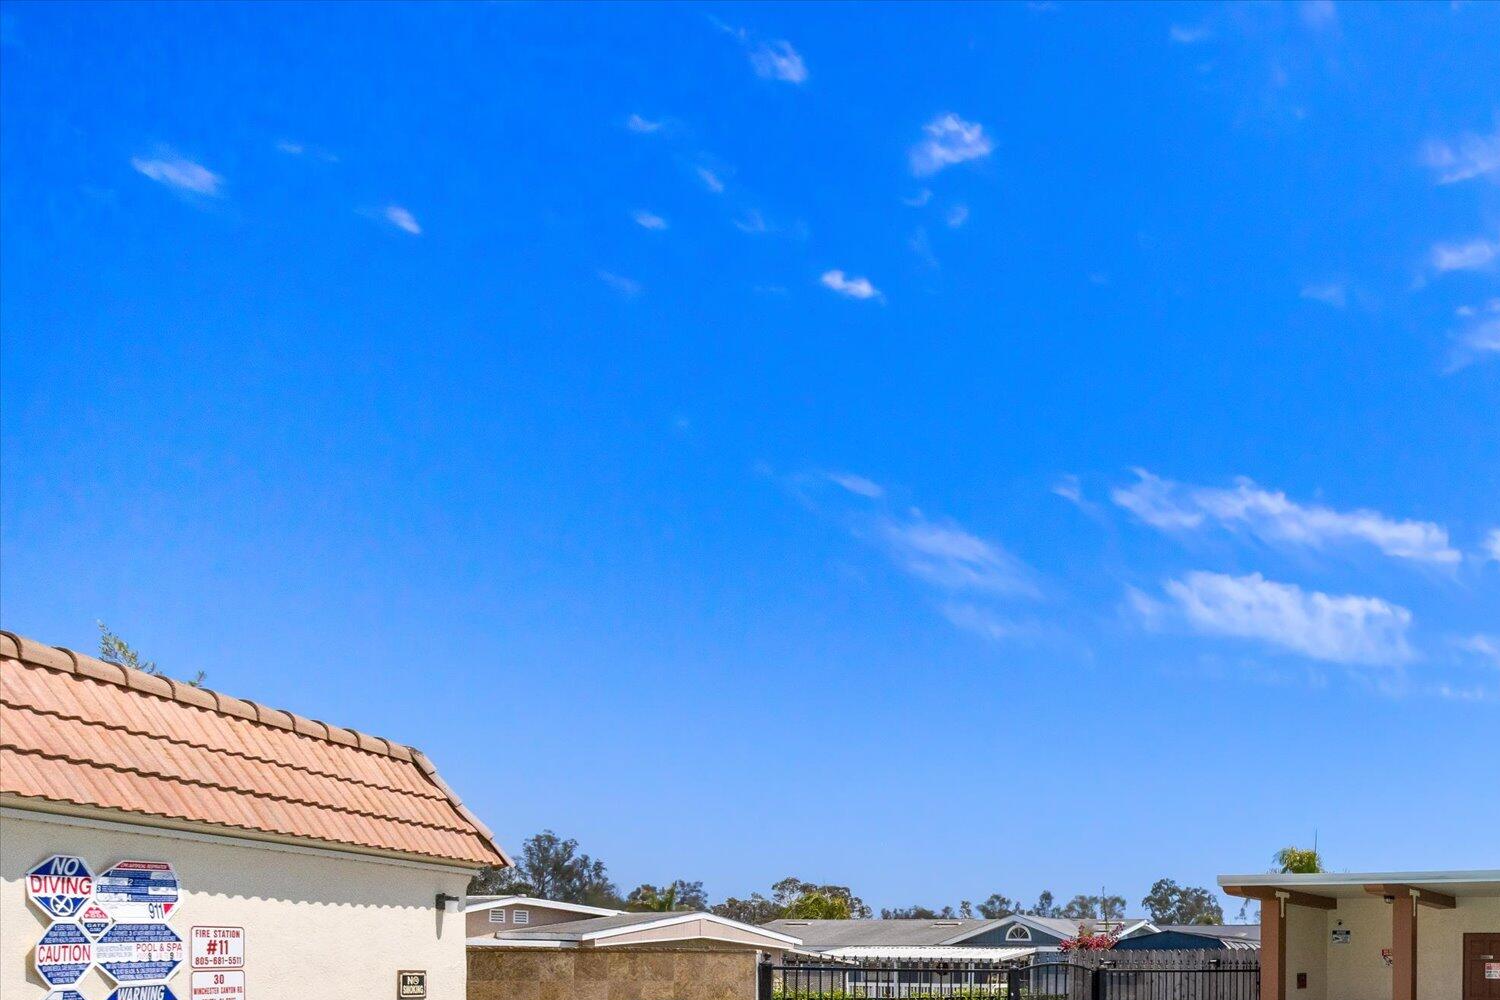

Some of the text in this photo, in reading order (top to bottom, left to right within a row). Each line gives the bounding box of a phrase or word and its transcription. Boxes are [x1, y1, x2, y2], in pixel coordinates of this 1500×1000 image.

[50, 857, 80, 876] NO
[30, 875, 93, 895] DIVING
[148, 902, 165, 919] 911
[195, 930, 241, 938] FIRE STATION
[136, 943, 158, 952] POOL
[159, 943, 165, 952] &
[166, 943, 183, 952] SPA
[207, 939, 229, 955] #11
[38, 944, 91, 963] CAUTION
[213, 974, 225, 985] 30
[407, 976, 420, 985] NO
[220, 986, 236, 994] CANYON
[403, 985, 424, 994] SMOKING
